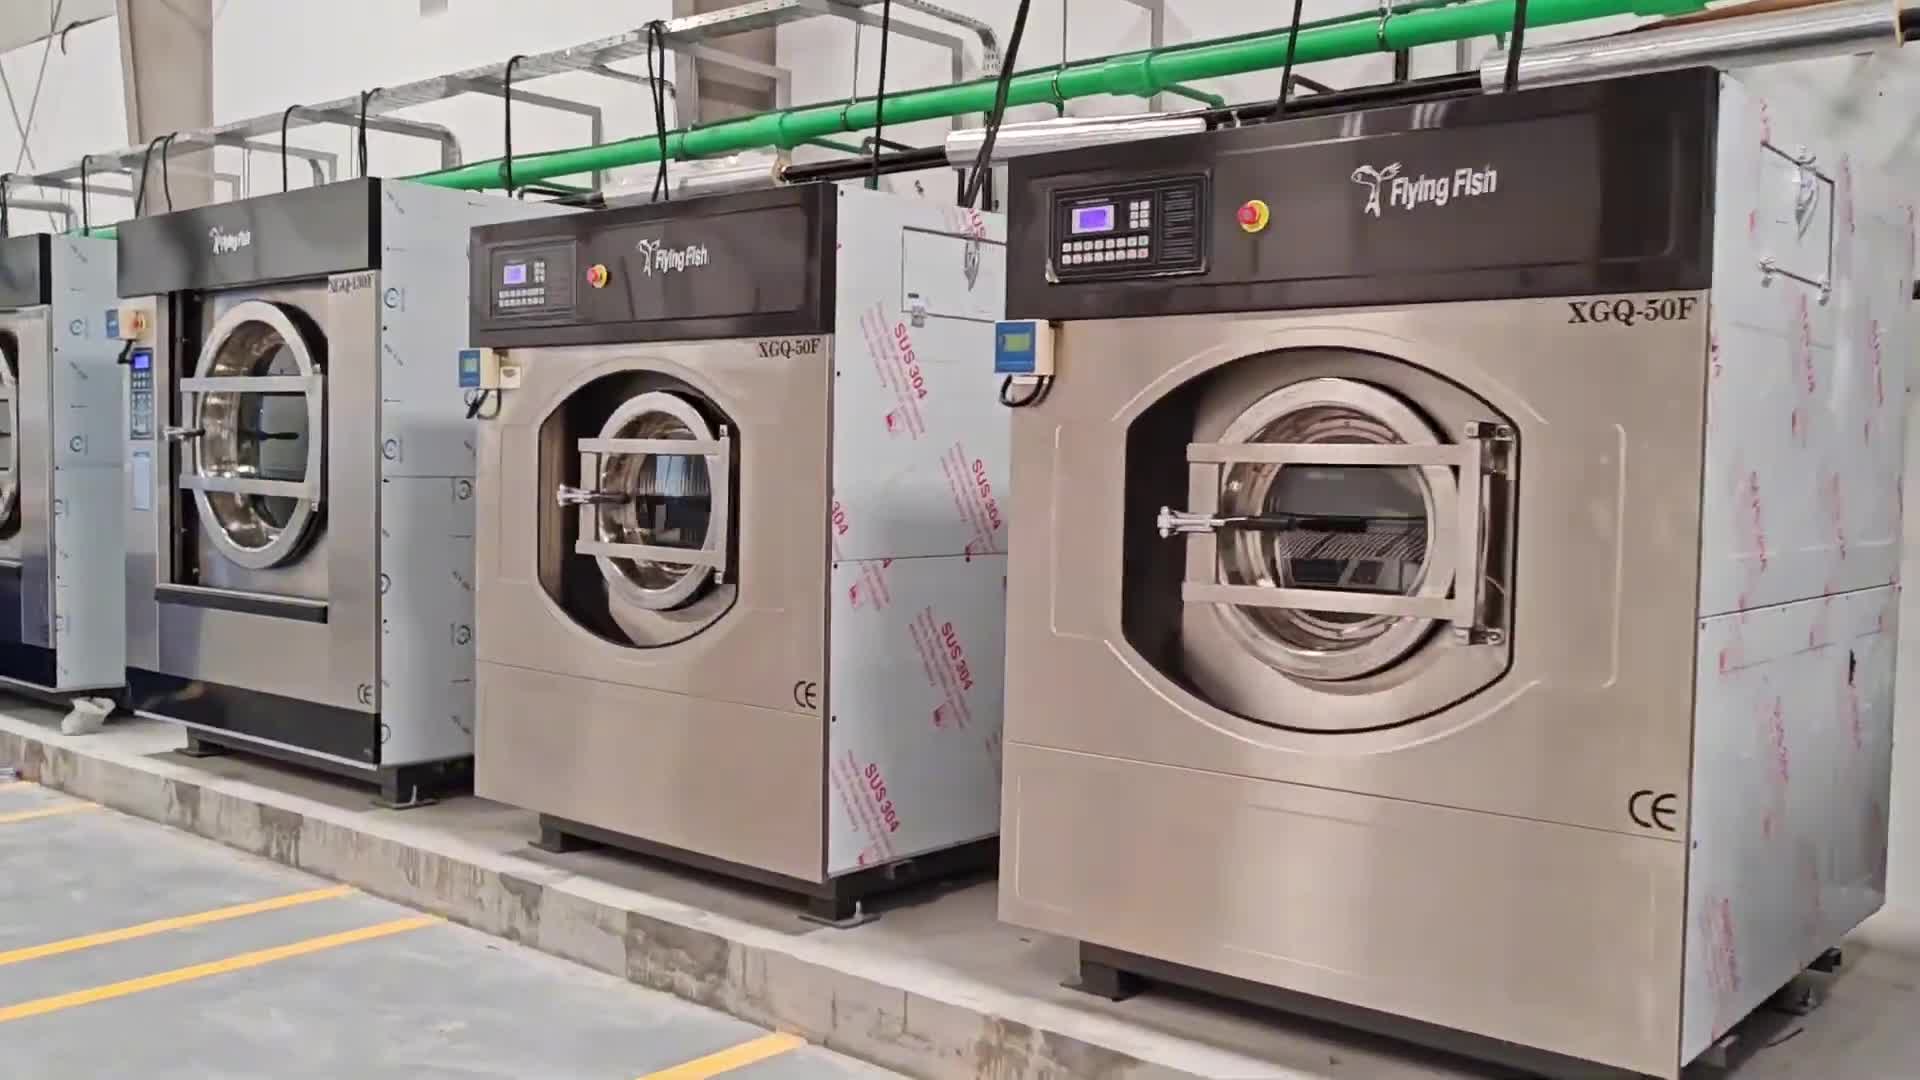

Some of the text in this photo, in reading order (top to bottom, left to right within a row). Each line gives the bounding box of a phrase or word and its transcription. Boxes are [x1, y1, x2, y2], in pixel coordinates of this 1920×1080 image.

[1390, 163, 1497, 210] Flying Fish
[655, 243, 708, 273] Flying Fish
[1567, 296, 1698, 327] XGQ-50F
[758, 337, 821, 360] XGQ-50F
[894, 322, 915, 365] SUS
[908, 365, 928, 399] 304
[972, 458, 990, 498] SUS
[984, 498, 1002, 530] 304
[941, 621, 962, 660] SUS
[955, 659, 974, 691] 304
[794, 680, 817, 710] CE
[865, 763, 887, 802] SUS
[880, 801, 900, 833] 304
[1628, 789, 1677, 832] CE
